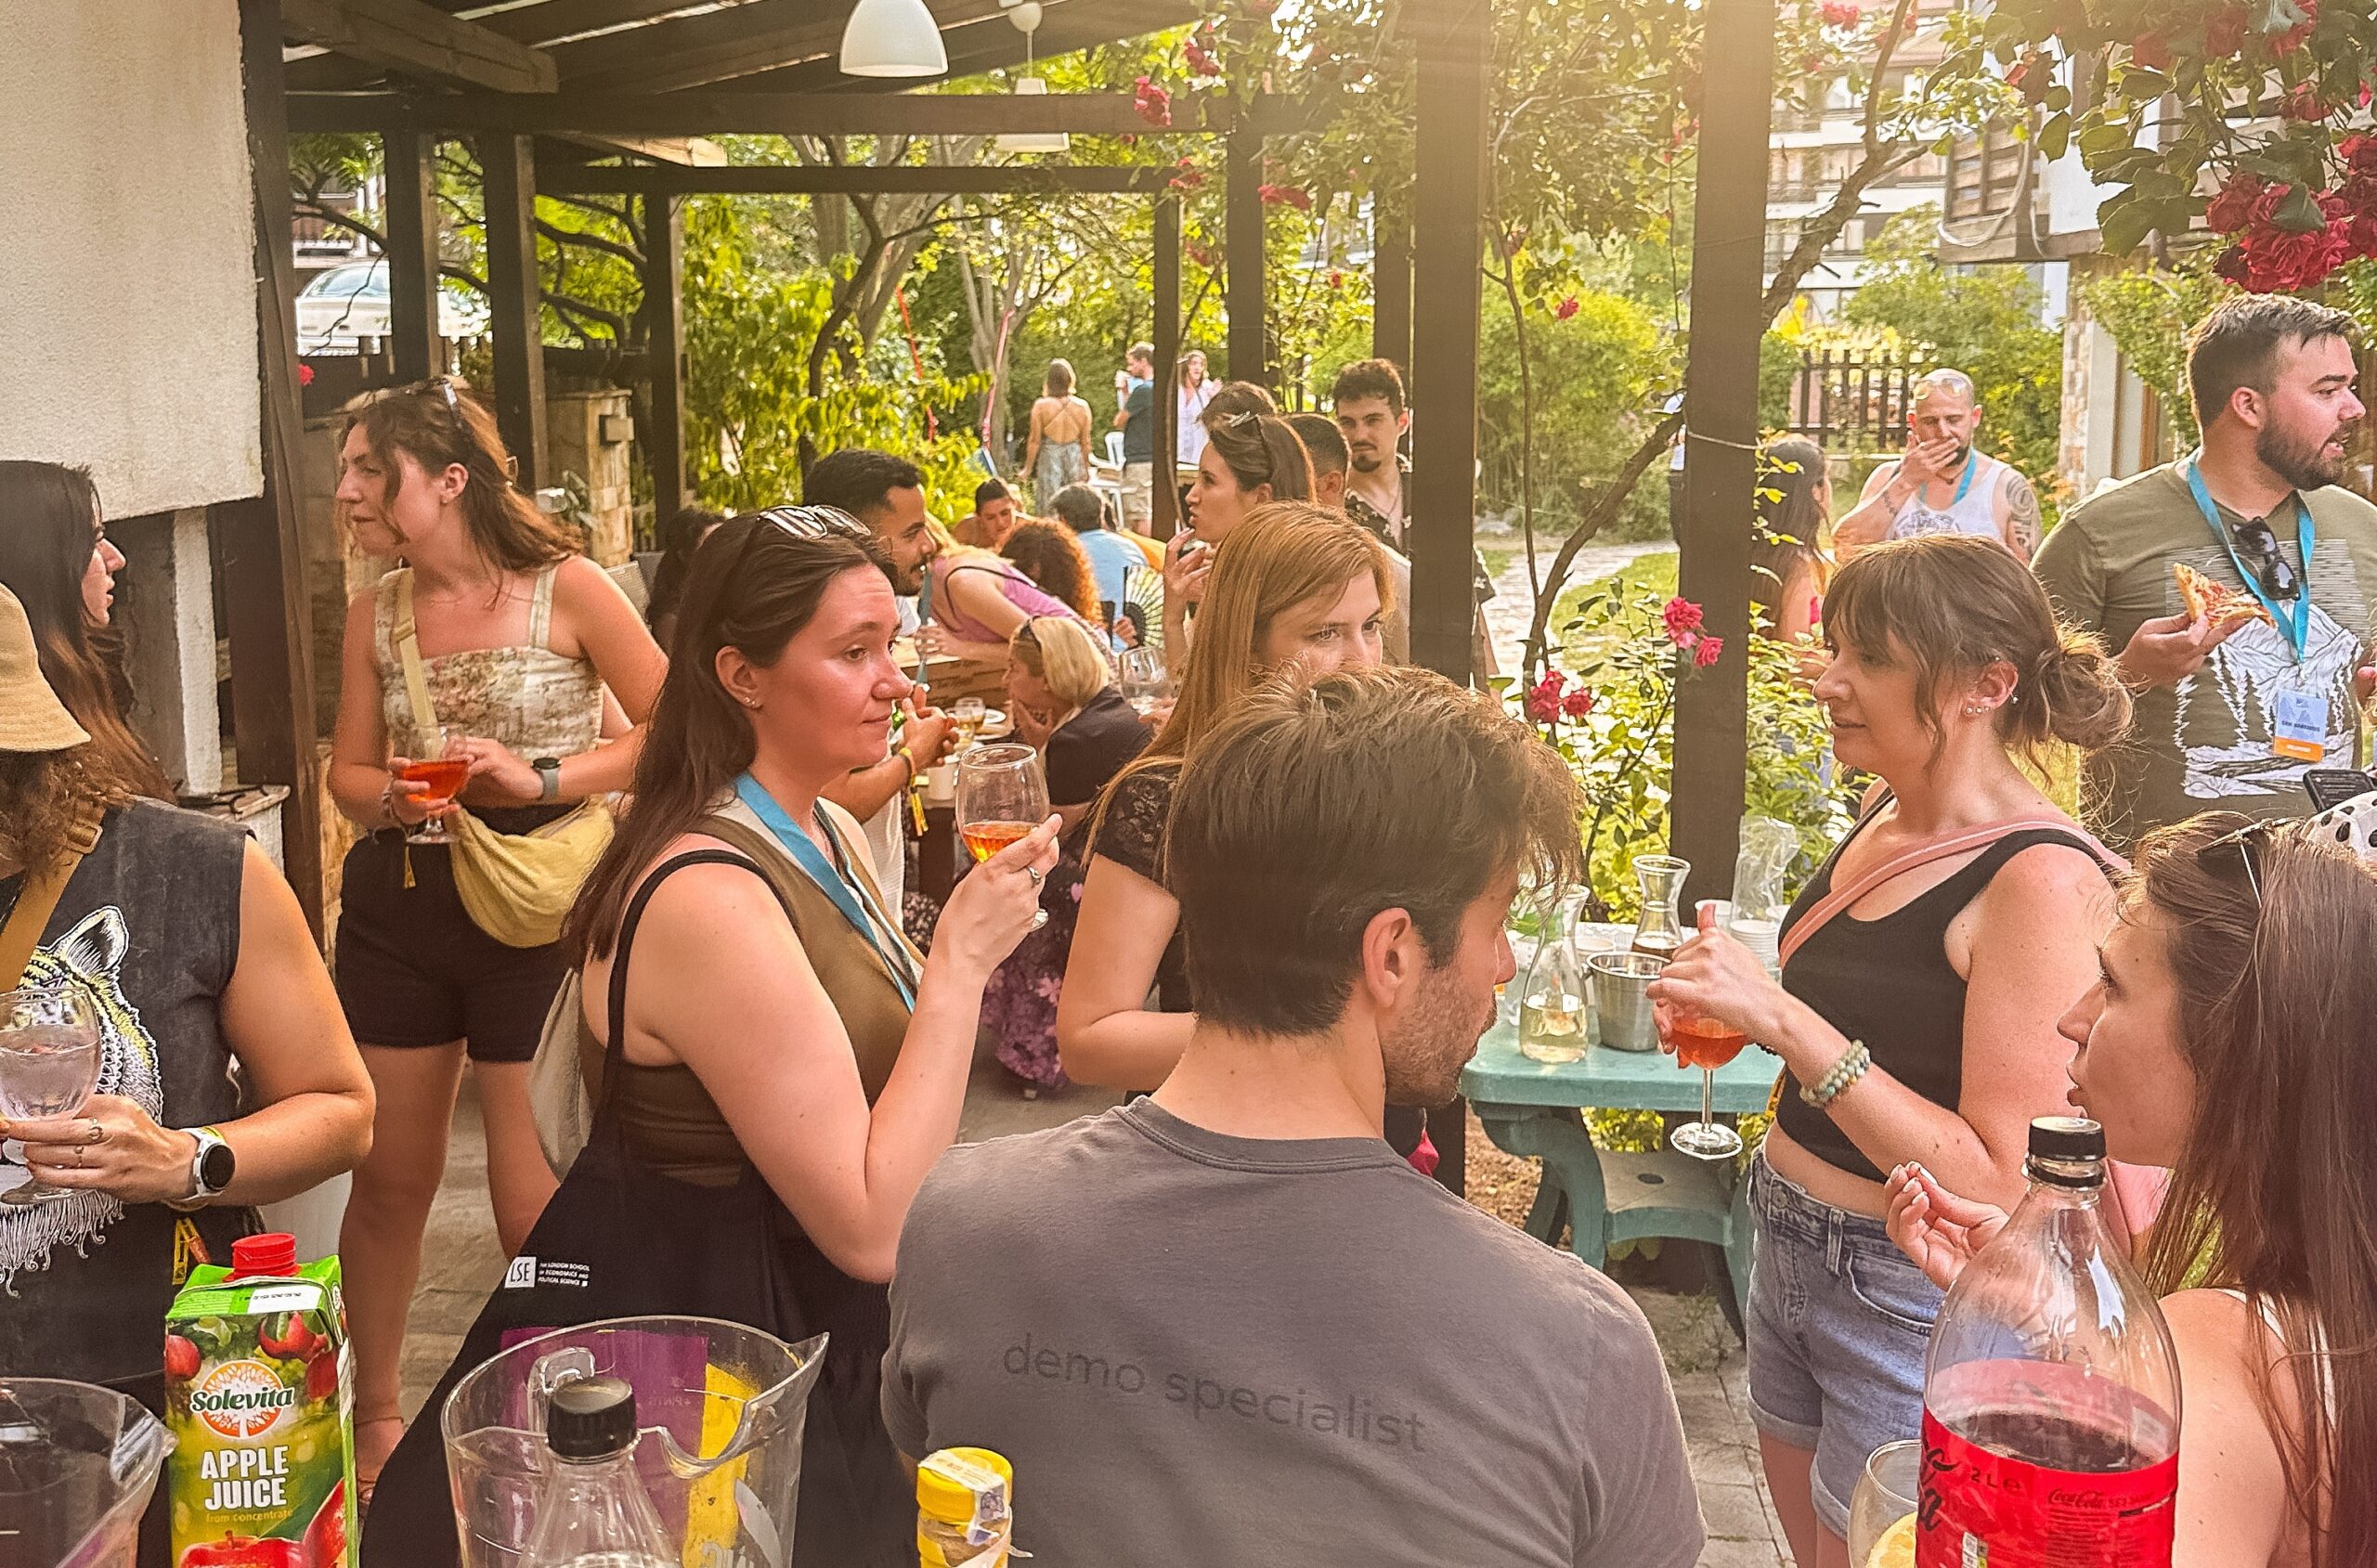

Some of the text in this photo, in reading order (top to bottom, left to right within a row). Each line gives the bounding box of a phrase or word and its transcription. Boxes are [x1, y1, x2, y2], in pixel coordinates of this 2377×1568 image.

[510, 1262, 530, 1283] LSE
[190, 1386, 294, 1412] Solevita
[1004, 1333, 1426, 1452] demo specialist
[201, 1445, 290, 1480] APPLE
[204, 1477, 288, 1510] JUICE
[206, 1510, 292, 1523] from concentrate
